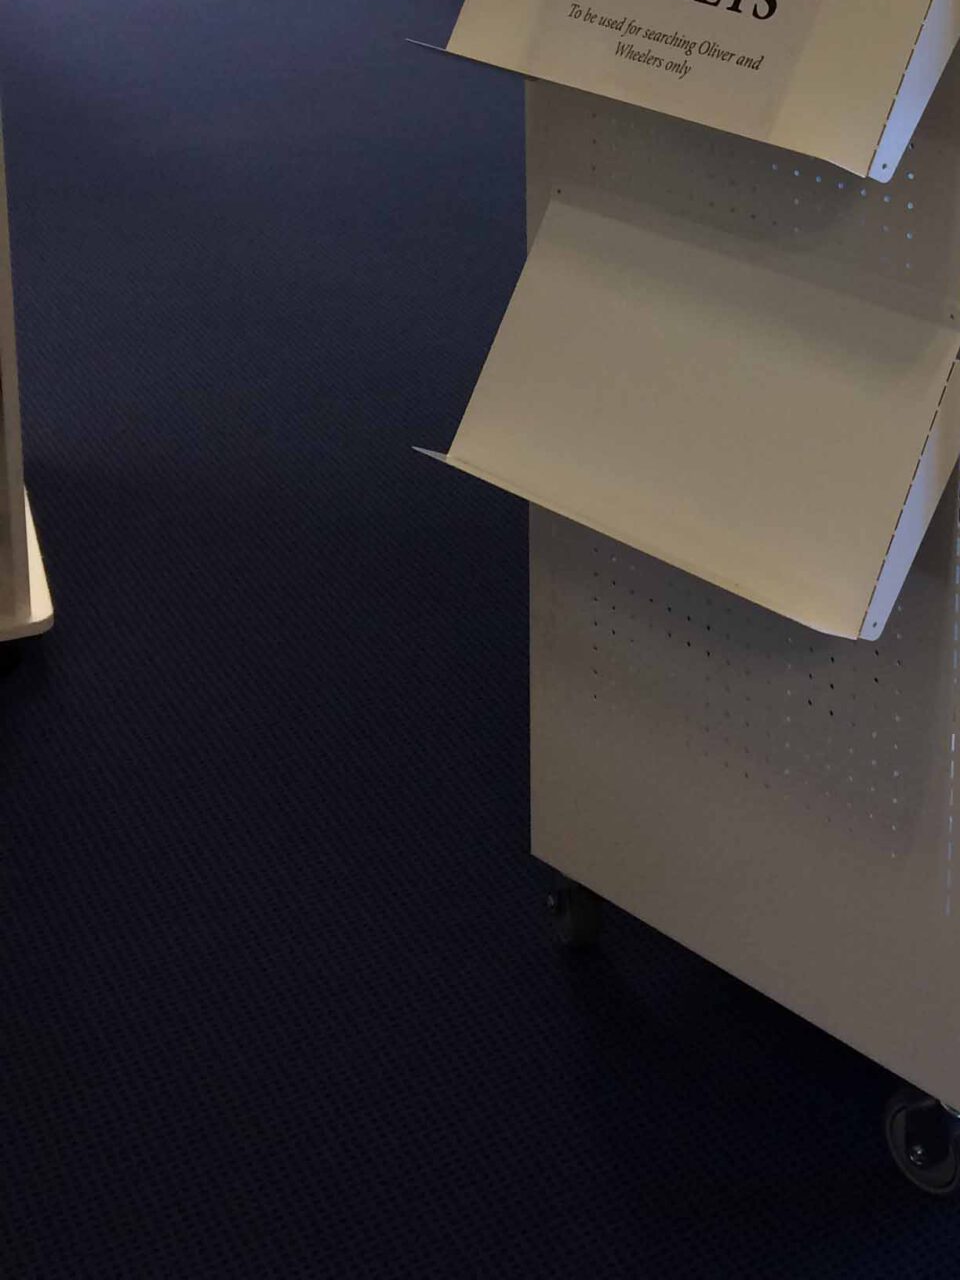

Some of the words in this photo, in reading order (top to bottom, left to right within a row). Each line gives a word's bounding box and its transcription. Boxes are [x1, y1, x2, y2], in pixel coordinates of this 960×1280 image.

[567, 2, 582, 19] To
[583, 7, 596, 25] be
[598, 15, 627, 33] used
[623, 19, 643, 38] for
[642, 27, 697, 57] searching
[697, 39, 736, 63] Oliver
[735, 54, 765, 72] and
[614, 40, 665, 69] Wheelers
[664, 60, 694, 81] only
